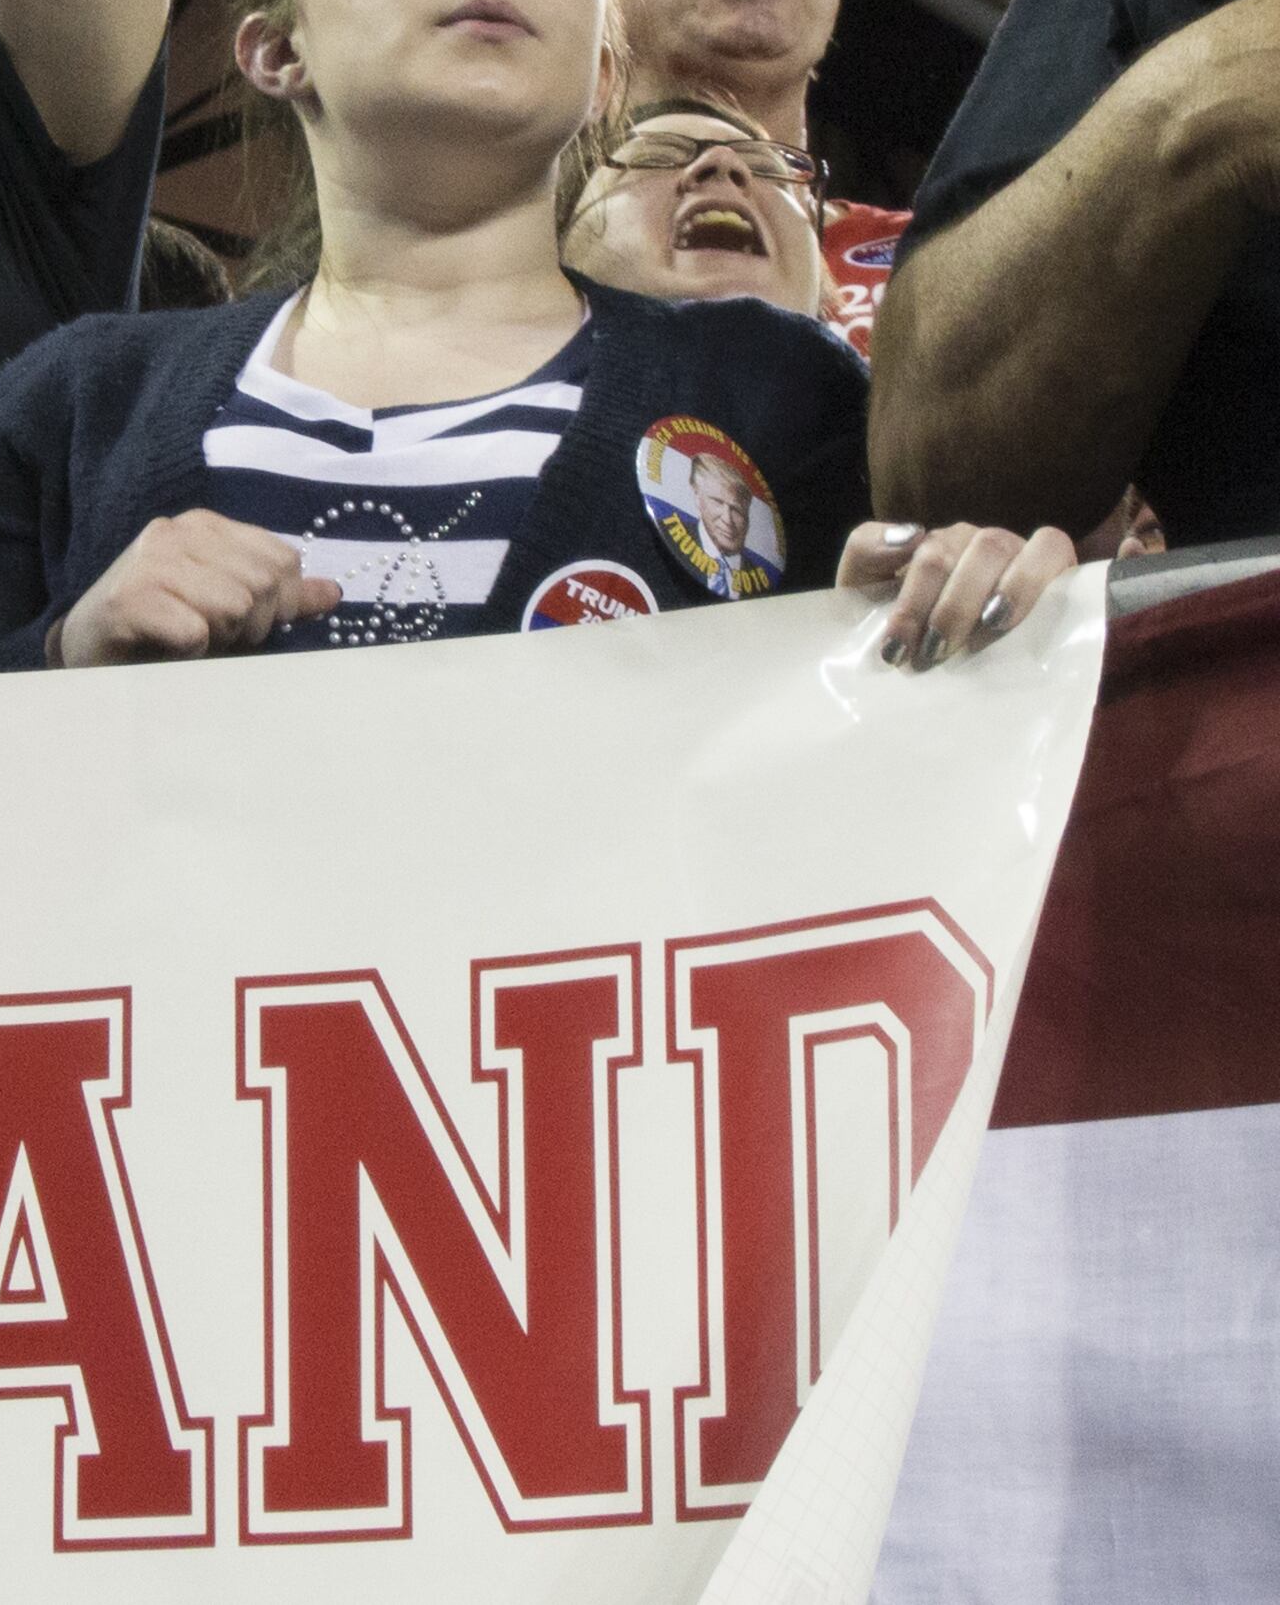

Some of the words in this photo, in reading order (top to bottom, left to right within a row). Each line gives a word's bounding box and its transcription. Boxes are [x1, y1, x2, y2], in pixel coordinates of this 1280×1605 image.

[662, 511, 721, 576] TRUMP
[730, 566, 770, 594] 2016
[565, 578, 637, 619] TRUM
